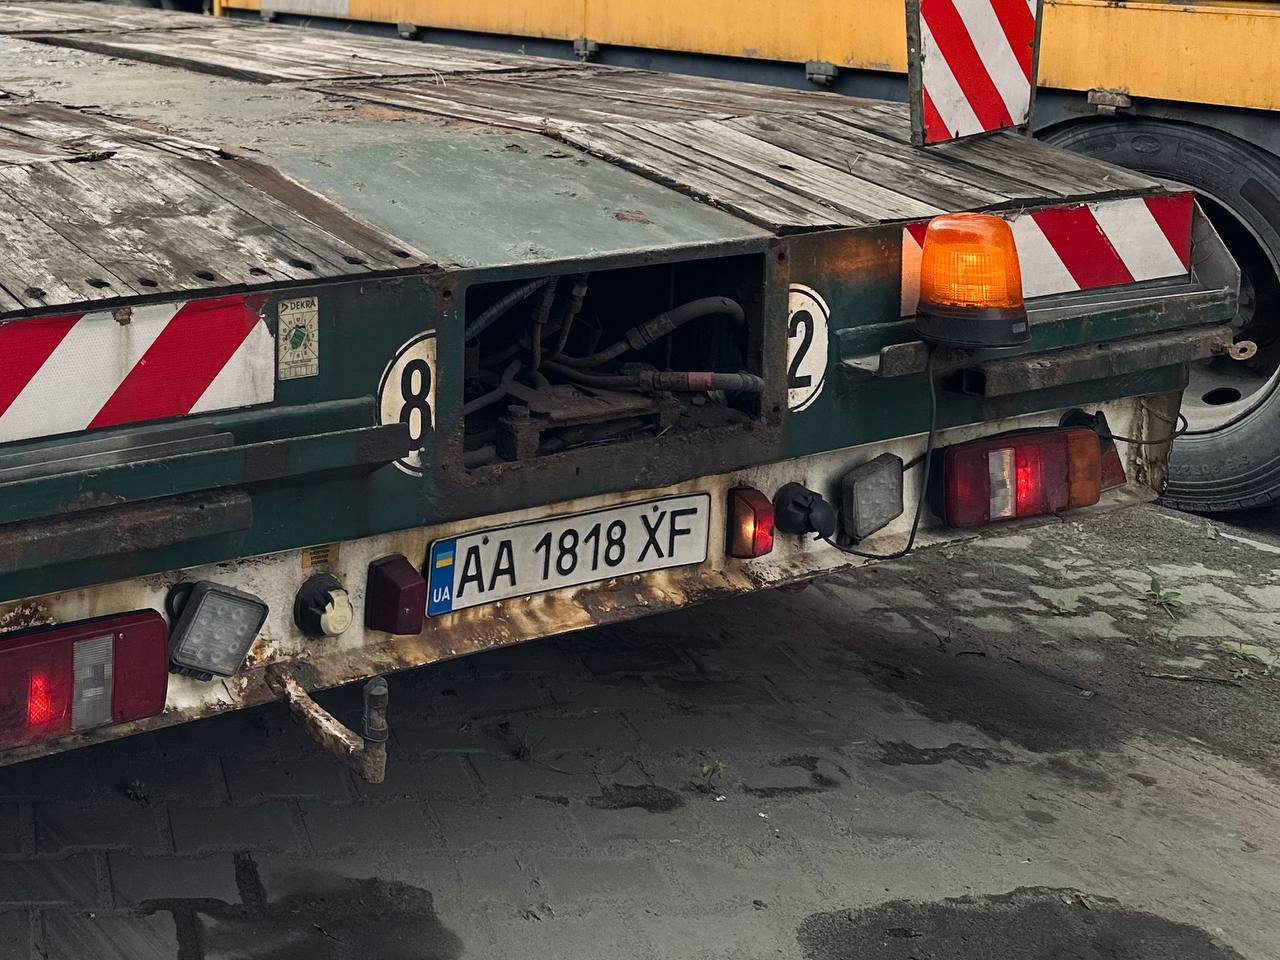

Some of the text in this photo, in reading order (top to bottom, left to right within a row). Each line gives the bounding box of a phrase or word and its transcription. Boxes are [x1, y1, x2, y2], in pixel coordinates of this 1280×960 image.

[290, 300, 316, 311] DEKRA
[432, 507, 698, 604] UA AA 1818 XF
